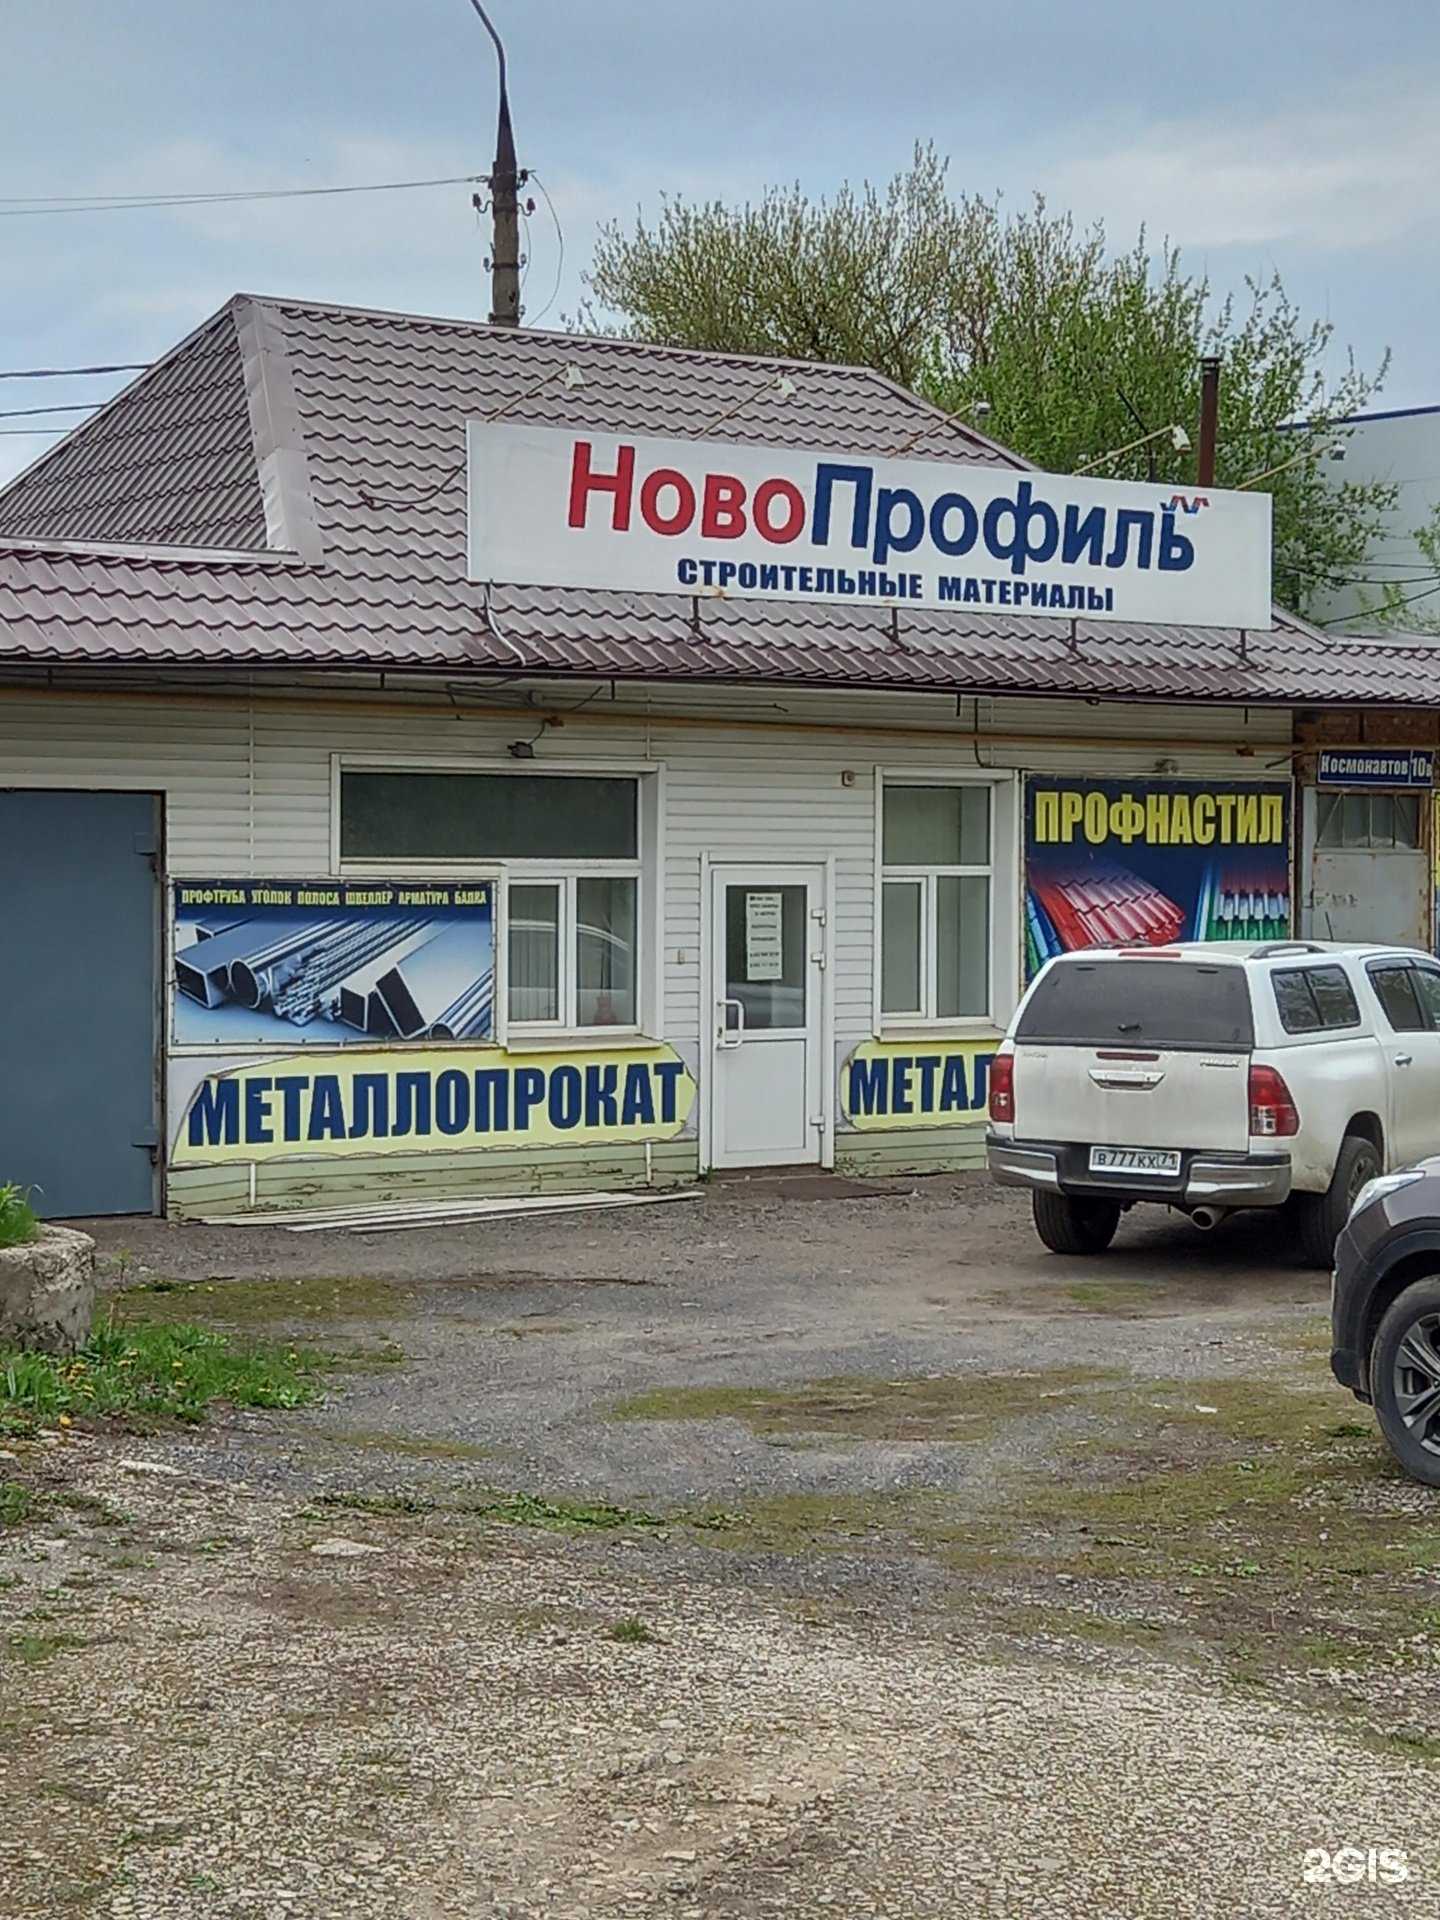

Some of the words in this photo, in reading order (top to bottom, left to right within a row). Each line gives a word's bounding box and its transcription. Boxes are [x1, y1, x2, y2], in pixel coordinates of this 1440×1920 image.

[677, 558, 923, 600] СТРОИТЕЛЬНЫЕ
[938, 576, 1115, 612] МАТЕРИАЛЫ
[1321, 755, 1408, 775] Космонавтов
[181, 889, 246, 904] ПРОФТРУБА
[251, 889, 292, 905] УГОЛОК
[297, 890, 340, 905] ПОЛОСА
[398, 891, 449, 905] АРМАТУРА
[454, 890, 487, 905] БАЛКА
[187, 1062, 685, 1147] МЕТАЛЛОПРОКАТ
